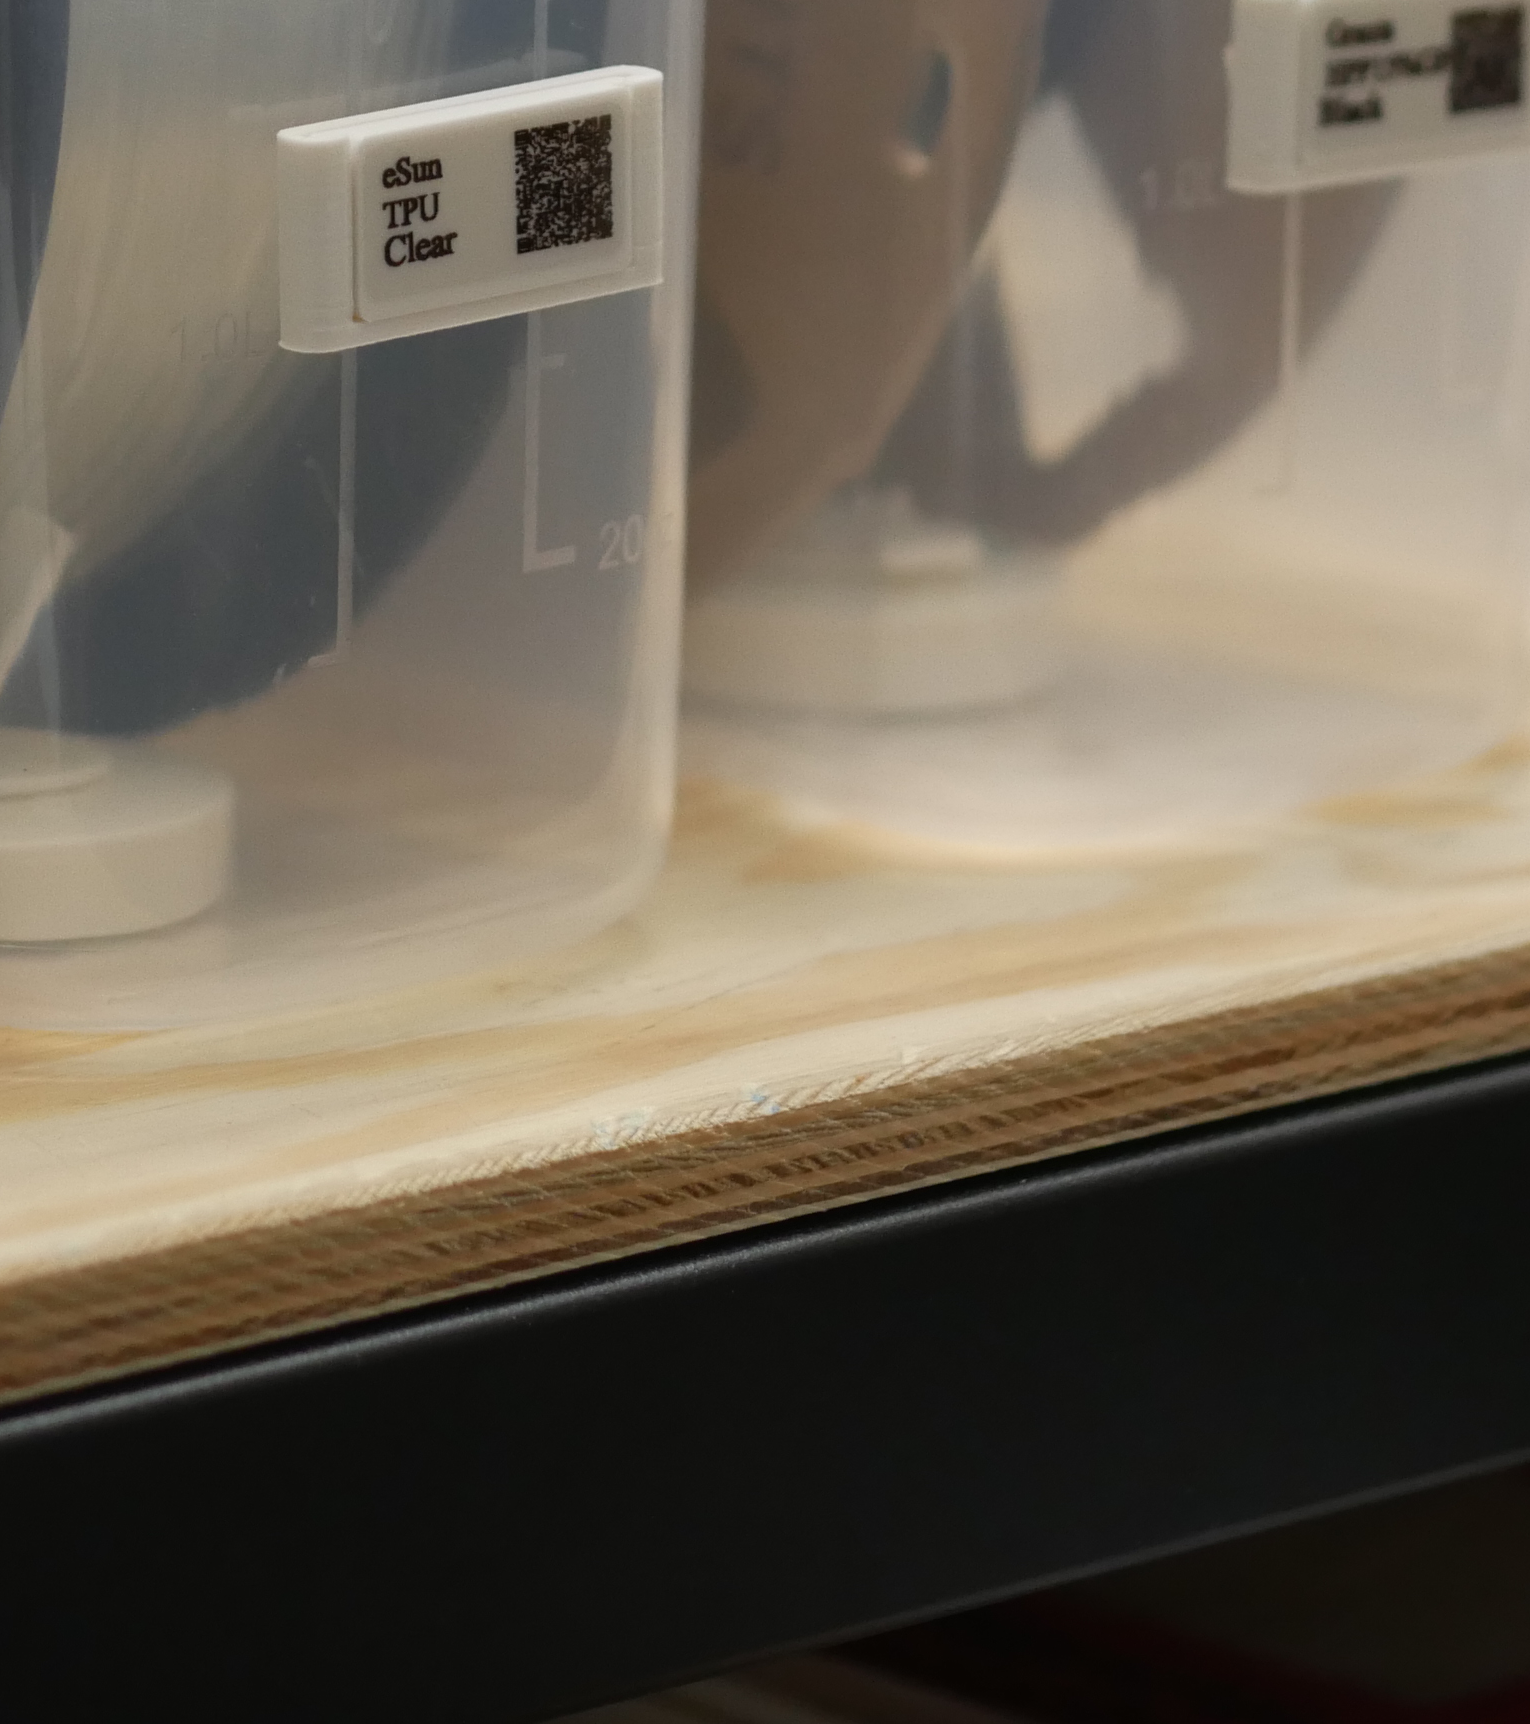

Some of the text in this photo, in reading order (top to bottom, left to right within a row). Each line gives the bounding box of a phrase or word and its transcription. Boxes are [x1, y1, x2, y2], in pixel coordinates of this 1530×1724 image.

[381, 156, 443, 189] eSun
[382, 191, 441, 230] TPU
[383, 230, 458, 268] Clear
